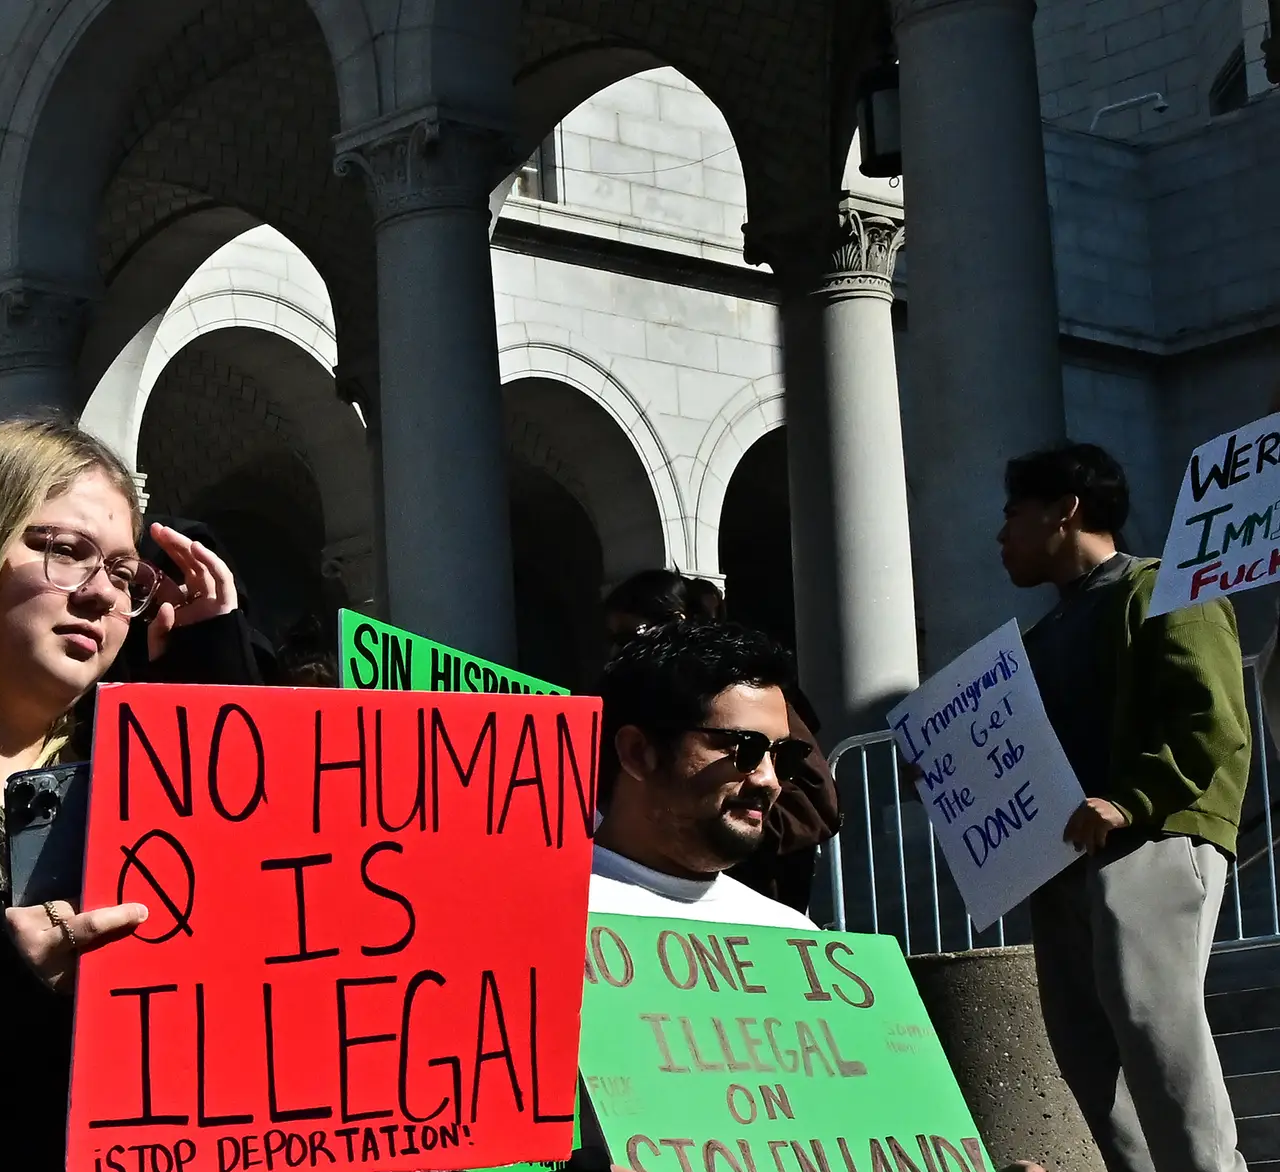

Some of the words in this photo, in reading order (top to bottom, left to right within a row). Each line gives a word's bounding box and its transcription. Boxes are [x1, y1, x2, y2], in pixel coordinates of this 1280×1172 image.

[1190, 432, 1280, 502] WE'R
[350, 623, 413, 691] SIN
[894, 649, 1019, 765] Immigrants
[118, 702, 268, 823] NO
[312, 705, 599, 849] HUMAN
[986, 738, 1025, 779] Job
[962, 780, 1039, 868] DONE
[261, 841, 417, 965] IS
[656, 929, 768, 994] ONE
[786, 937, 875, 1009] IS
[88, 966, 574, 1129] ILLEGAL
[639, 1012, 869, 1078] ILLEGAL
[726, 1083, 796, 1125] ON
